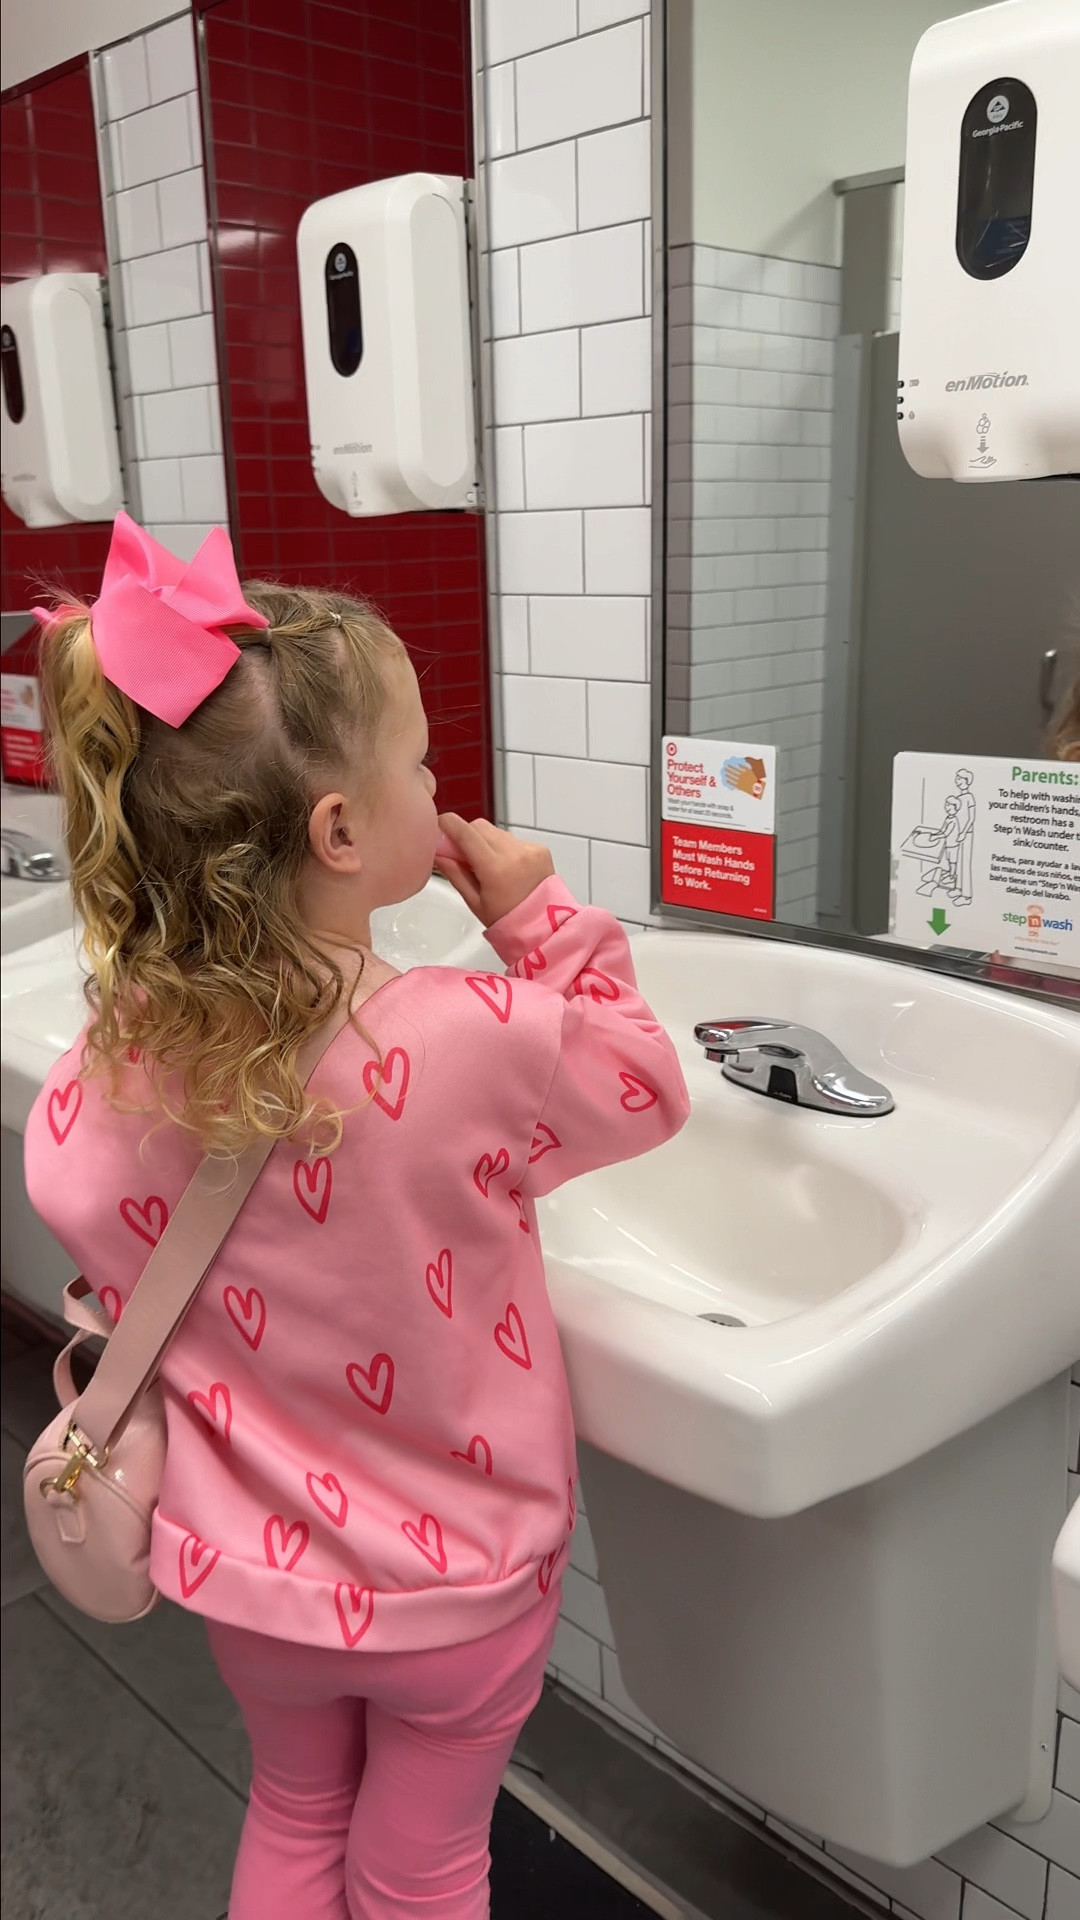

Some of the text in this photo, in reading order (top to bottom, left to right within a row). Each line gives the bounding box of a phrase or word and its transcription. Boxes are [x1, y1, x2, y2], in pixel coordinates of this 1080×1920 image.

[972, 120, 1024, 138] Georgia-Pacific
[667, 759, 704, 773] Protect
[667, 771, 717, 788] Yourself &
[1011, 766, 1079, 786] Parents:
[667, 784, 702, 798] Others
[998, 788, 1008, 798] To
[1010, 789, 1029, 801] help
[1031, 791, 1050, 802] with
[988, 801, 1008, 810] your
[1009, 802, 1050, 814] children's
[1010, 815, 1075, 828] restroom has a
[993, 823, 1013, 836] Step
[1022, 826, 1046, 837] Wash
[1048, 830, 1075, 841] under
[672, 835, 743, 855] Team Members
[1012, 838, 1069, 852] sink/counter.
[672, 849, 755, 871] Must Wash Hands
[991, 853, 1016, 864] Padres,
[1018, 858, 1035, 866] para
[672, 862, 750, 886] Before Returning
[990, 864, 1000, 872] las
[1001, 866, 1026, 875] manos
[1026, 868, 1036, 876] de
[1037, 870, 1049, 878] sus
[672, 874, 712, 890] To Work.
[1009, 876, 1027, 885] tiene
[1006, 885, 1071, 901] debajo del lavabo.
[1002, 912, 1027, 927] step
[1042, 918, 1073, 931] wash
